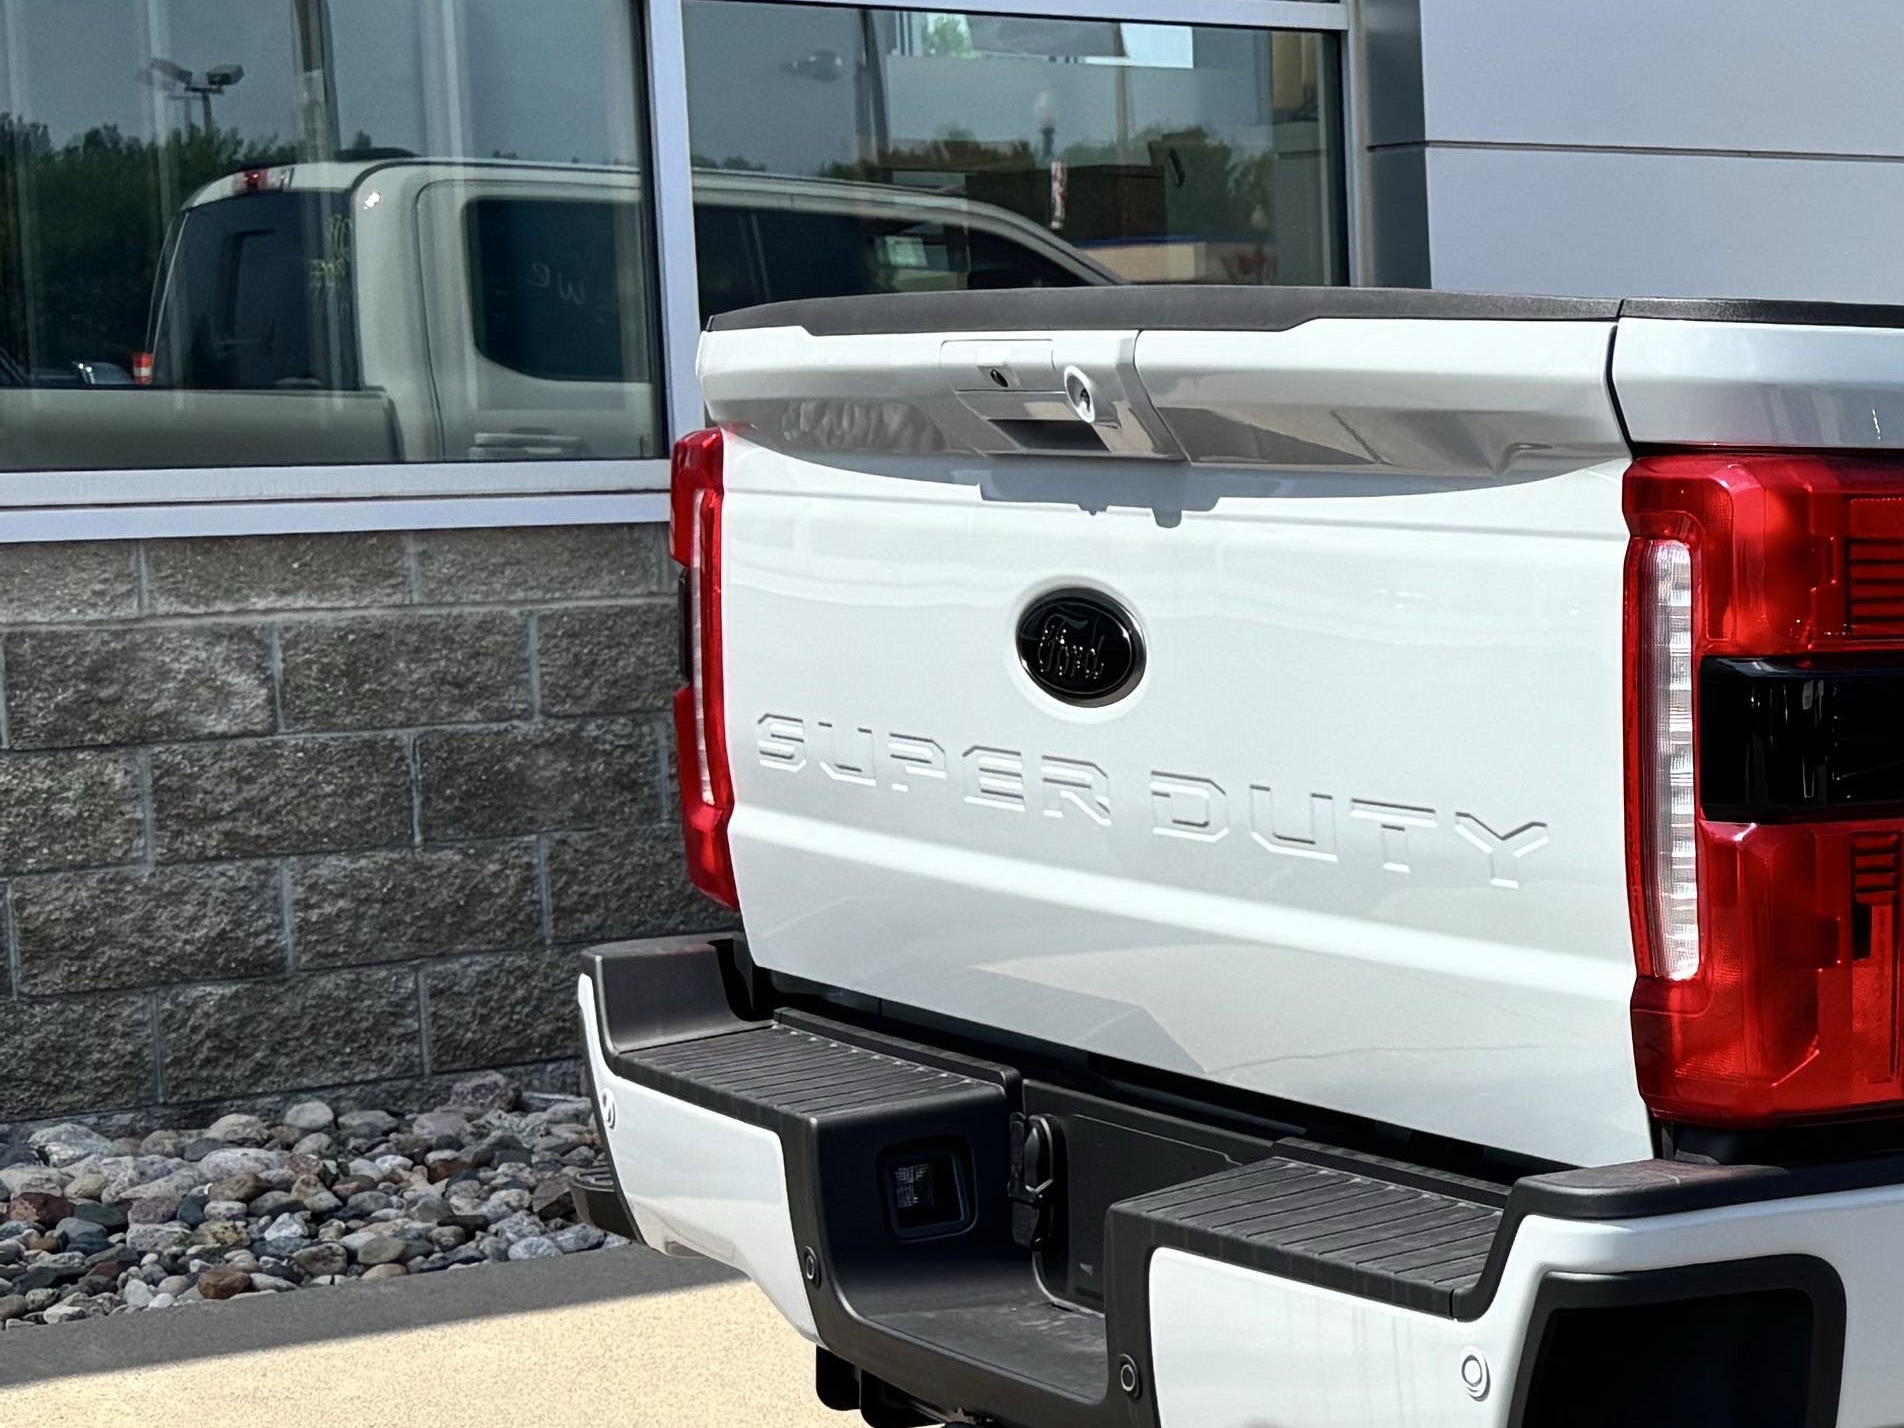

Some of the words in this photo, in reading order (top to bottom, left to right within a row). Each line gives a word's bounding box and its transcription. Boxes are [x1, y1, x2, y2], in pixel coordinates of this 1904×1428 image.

[1037, 612, 1105, 681] Ford
[756, 712, 1112, 827] SUPER
[1149, 769, 1550, 890] DUTY
